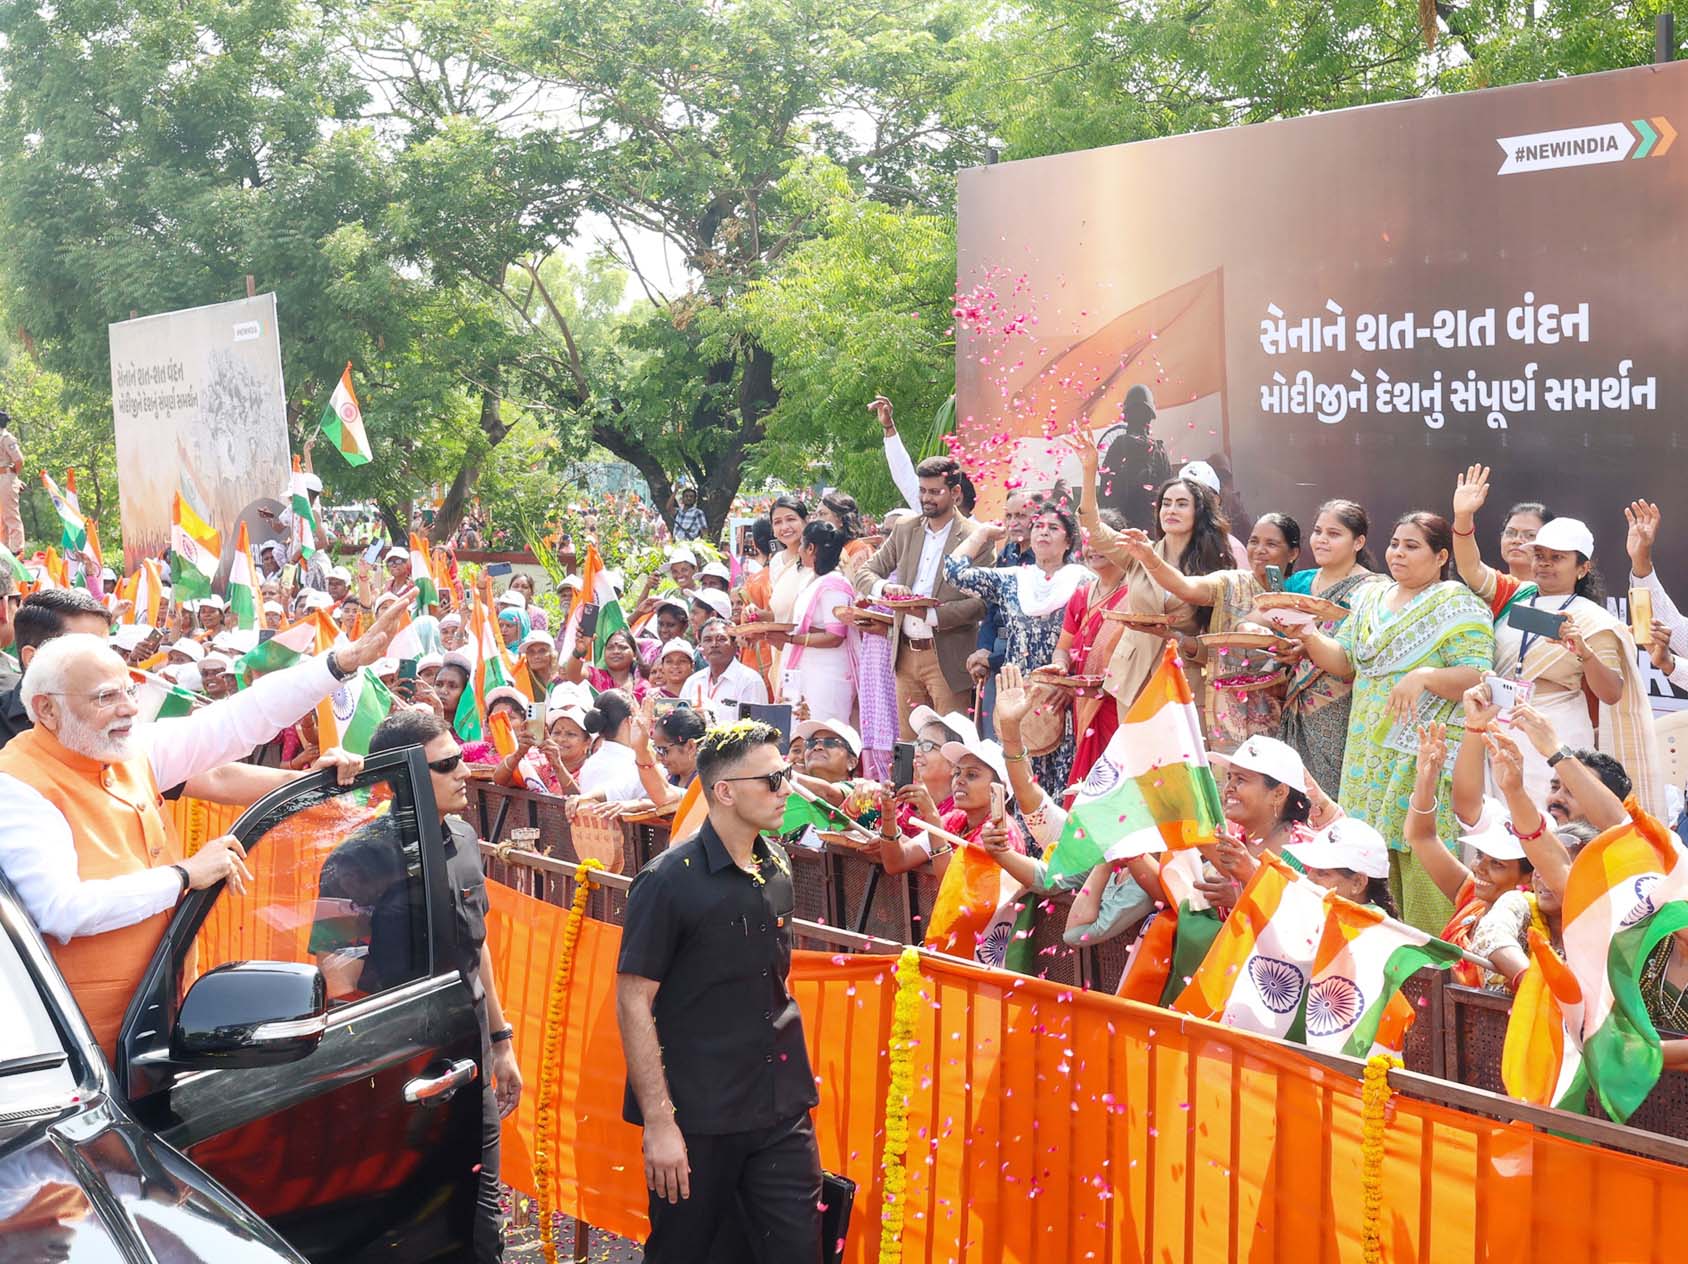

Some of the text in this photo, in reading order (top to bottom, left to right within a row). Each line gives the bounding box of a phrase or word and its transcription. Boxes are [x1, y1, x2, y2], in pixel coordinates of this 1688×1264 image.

[1515, 135, 1619, 163] #NEWINDIA
[1259, 291, 1589, 354] સેનાને શત-શત વંદન
[1260, 359, 1657, 429] મોદીજીને દેશનું સંપૂર્ણ સમર્થન
